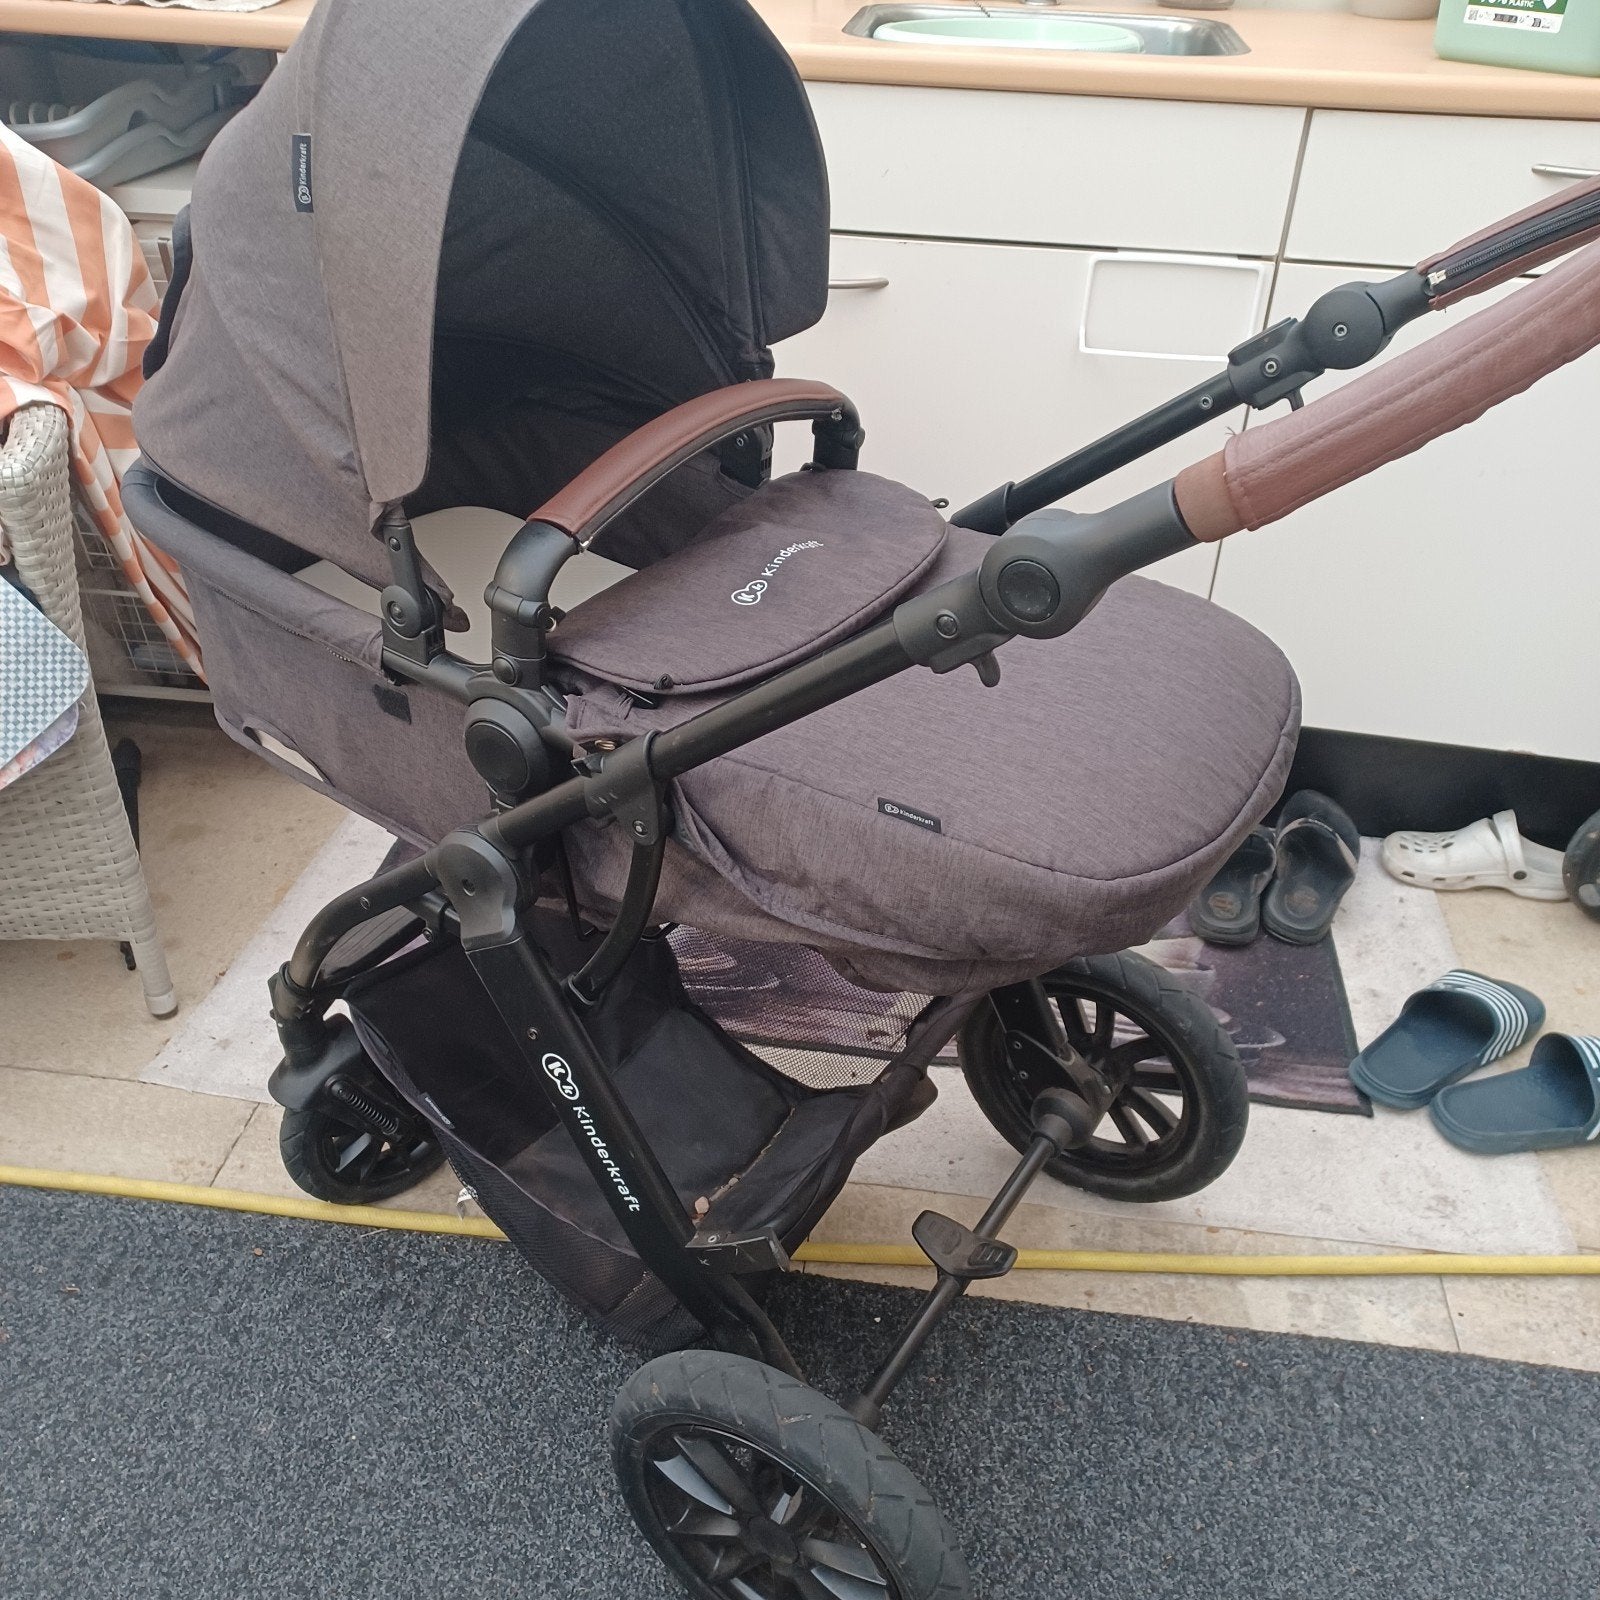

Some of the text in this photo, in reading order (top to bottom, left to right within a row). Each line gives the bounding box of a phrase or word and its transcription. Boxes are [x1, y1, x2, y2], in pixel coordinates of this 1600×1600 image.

[1508, 0, 1535, 8] PLASTIC
[299, 143, 307, 185] Kinderkraft
[761, 540, 824, 577] Kinderkraft
[573, 1106, 640, 1212] Kinderkraft
